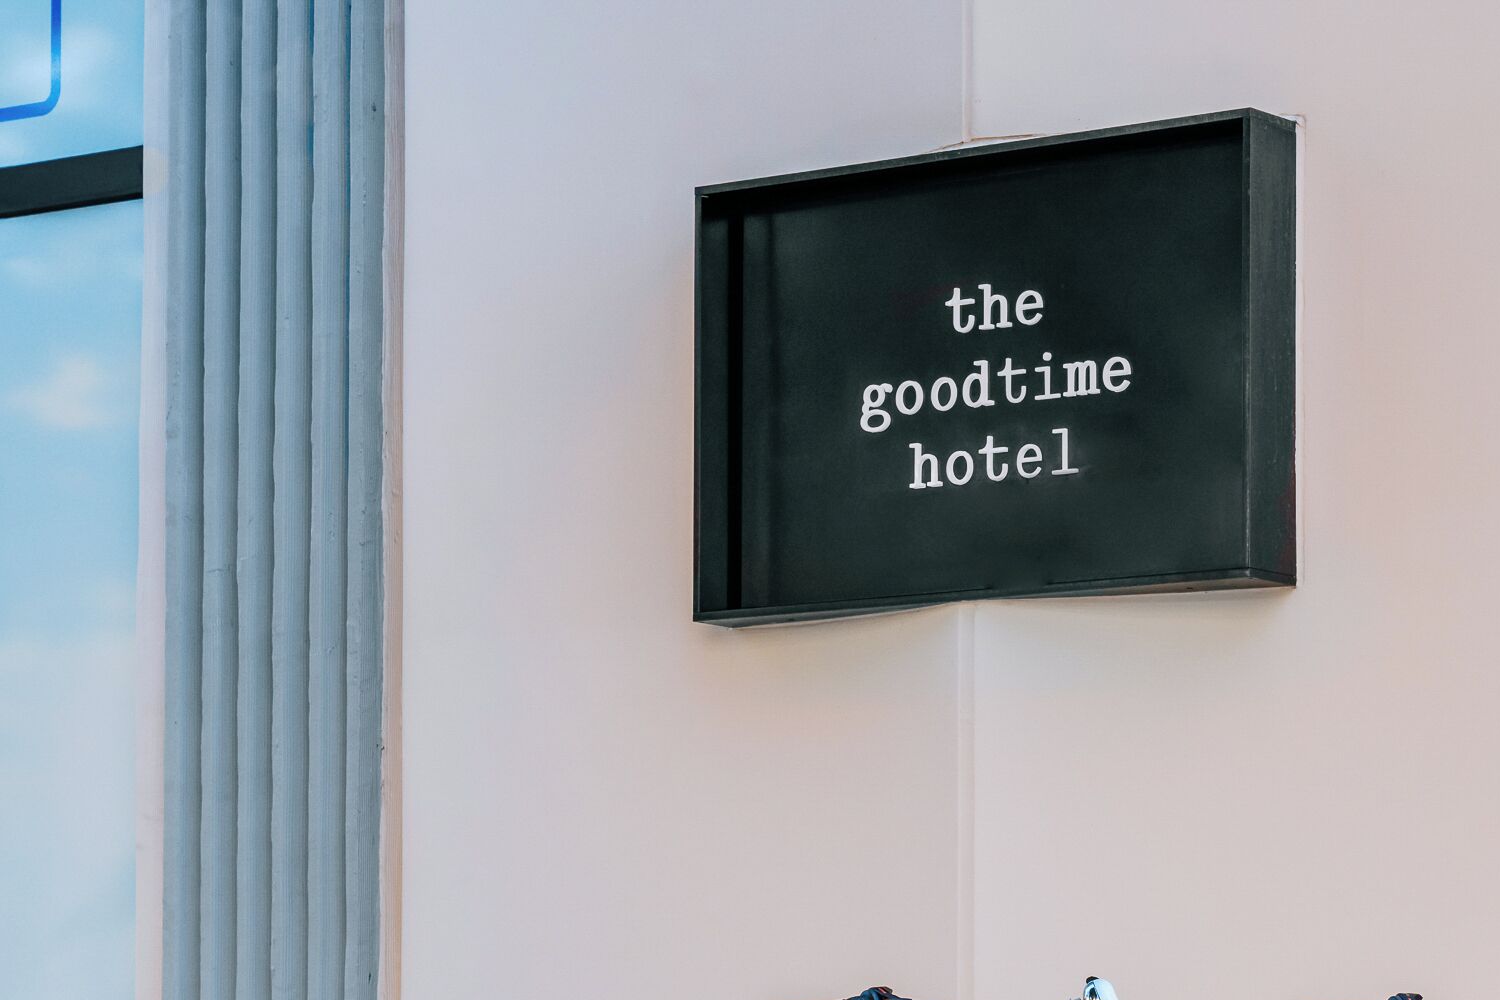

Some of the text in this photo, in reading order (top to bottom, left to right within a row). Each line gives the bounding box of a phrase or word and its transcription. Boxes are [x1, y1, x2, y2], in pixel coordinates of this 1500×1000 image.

[945, 283, 1044, 334] the
[859, 352, 1132, 433] goodtime
[908, 428, 1079, 490] hotel
